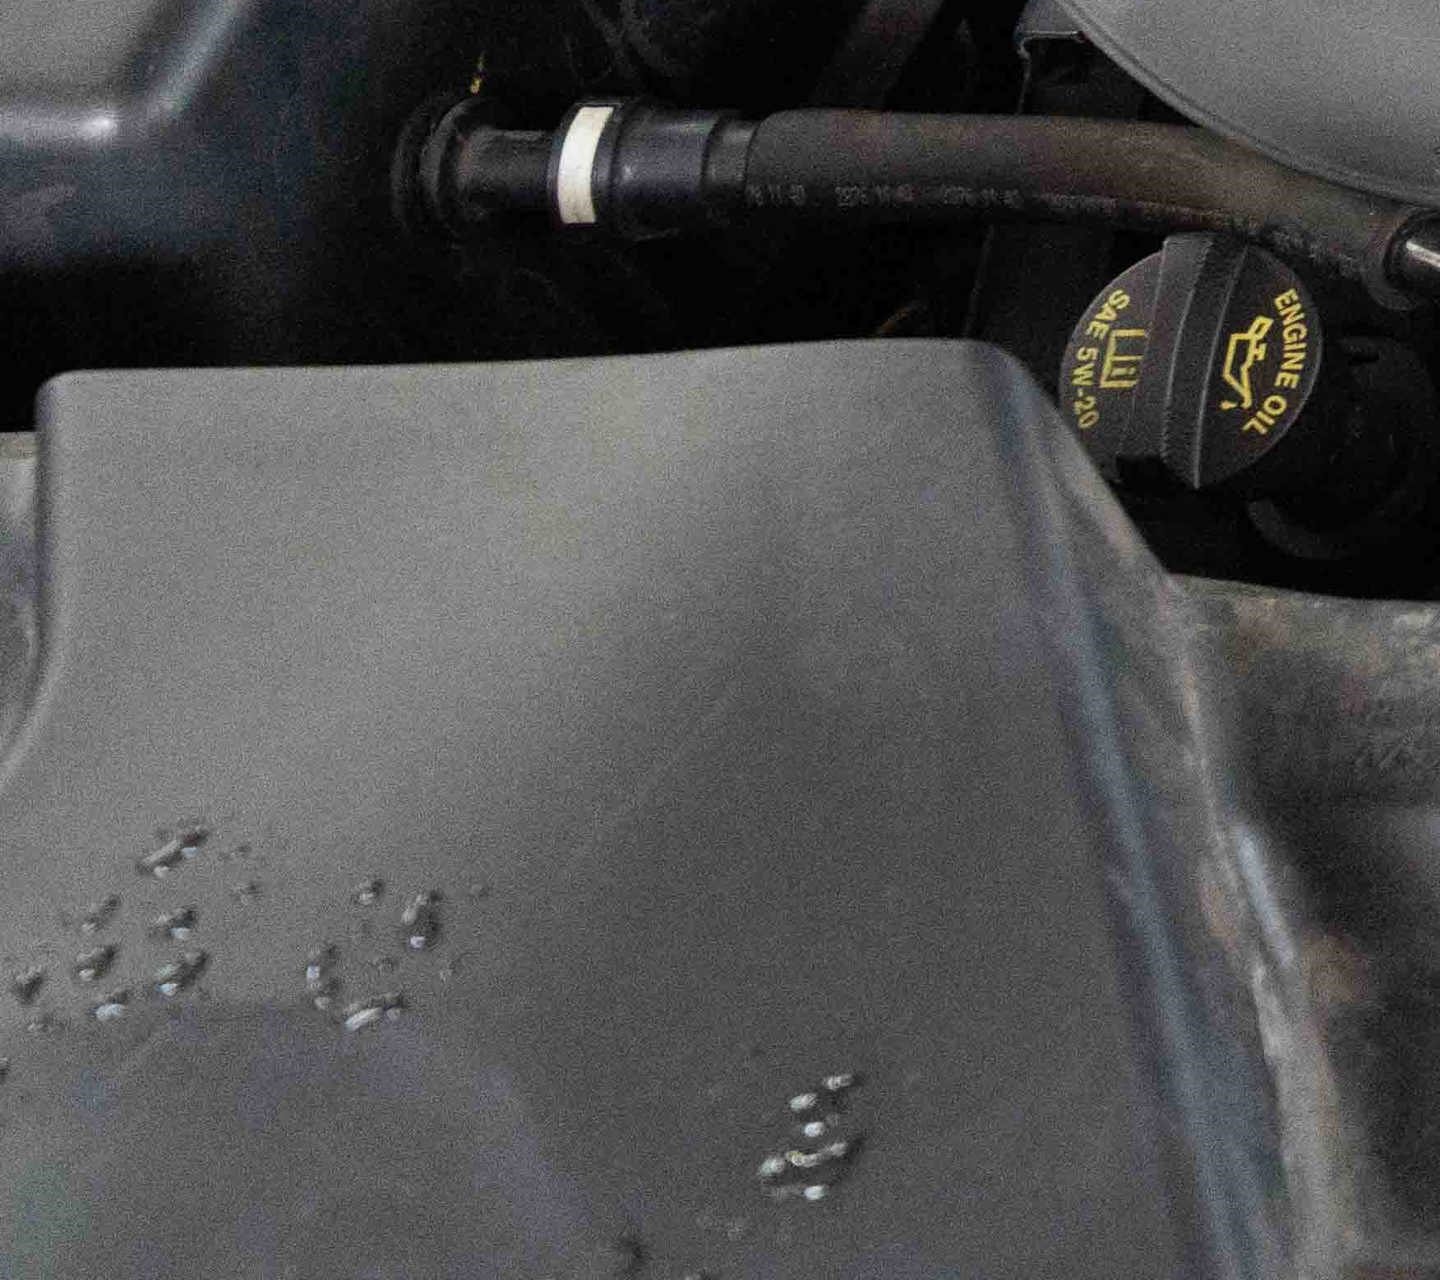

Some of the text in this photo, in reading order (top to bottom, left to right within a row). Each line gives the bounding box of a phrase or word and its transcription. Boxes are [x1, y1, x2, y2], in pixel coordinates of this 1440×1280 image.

[1071, 288, 1131, 430] SAE 5W-20
[1242, 288, 1309, 437] ENGINE OIL
